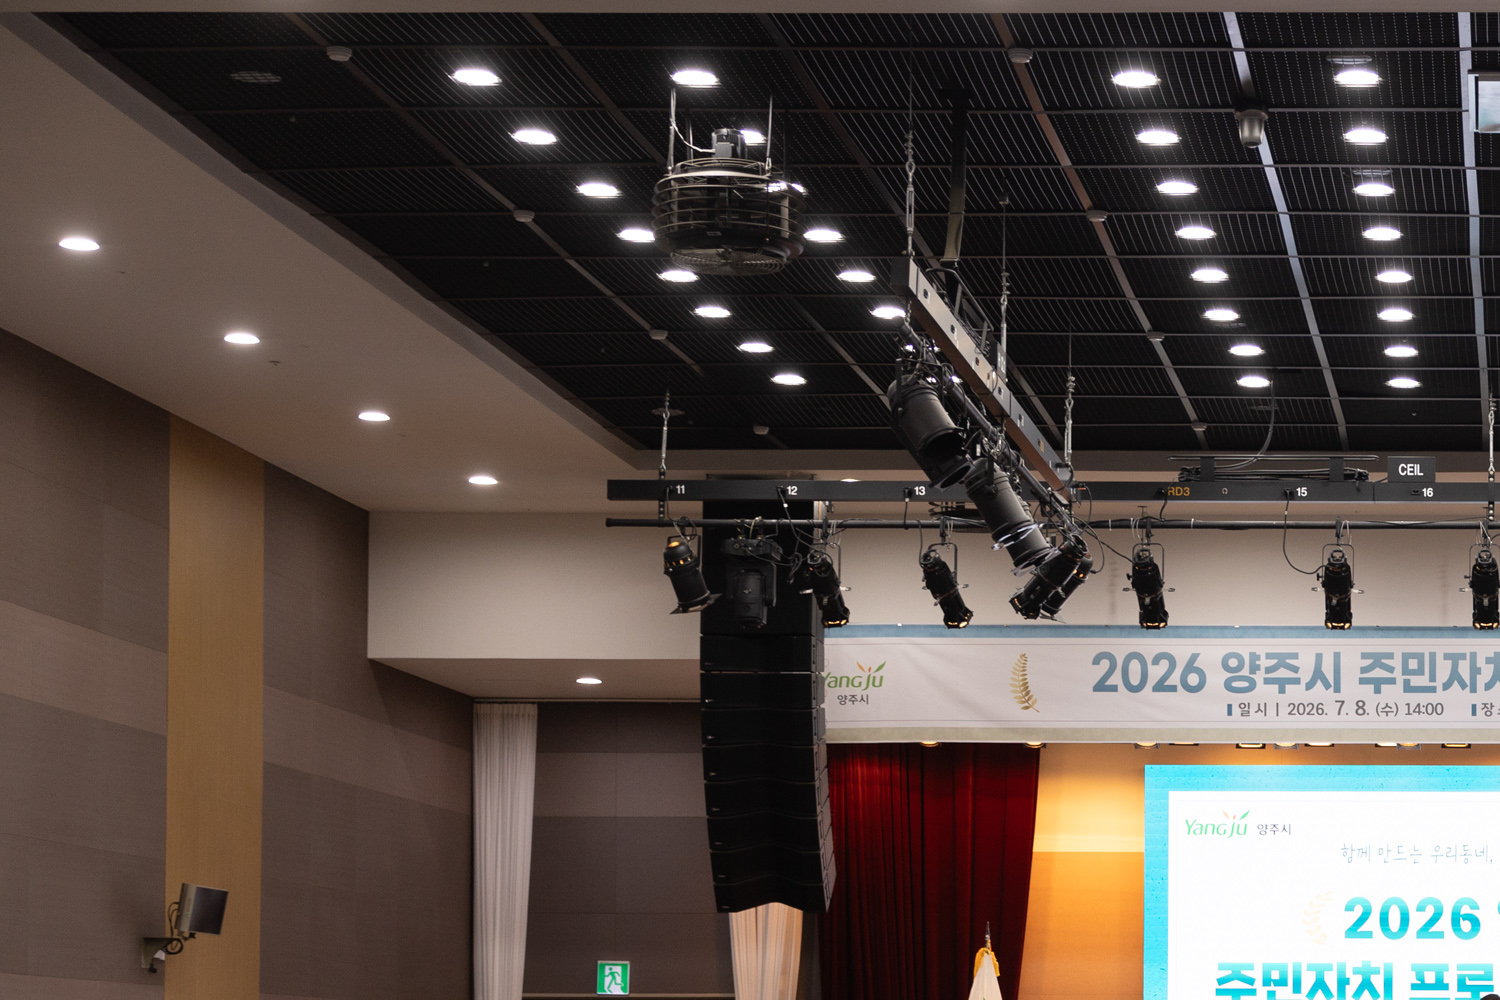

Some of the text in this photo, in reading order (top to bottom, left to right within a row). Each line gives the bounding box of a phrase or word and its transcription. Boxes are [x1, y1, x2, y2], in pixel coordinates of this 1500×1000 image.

[1398, 464, 1424, 476] CEIL
[676, 485, 686, 495] 11
[786, 485, 798, 495] 12
[914, 485, 926, 495] 13
[1168, 486, 1190, 496] RD3
[1295, 486, 1308, 497] 15
[1421, 487, 1434, 497] 16
[1091, 651, 1207, 694] 2026
[1221, 651, 1343, 694] 양주시
[837, 694, 869, 706] 양주시
[1288, 702, 1328, 716] 2026.
[1375, 701, 1399, 717] (수)
[1404, 702, 1445, 716] 14:00
[1256, 823, 1292, 836] 양주시
[1340, 842, 1371, 864] 함께
[1377, 844, 1423, 865] 만드는
[1343, 896, 1482, 941] 2026
